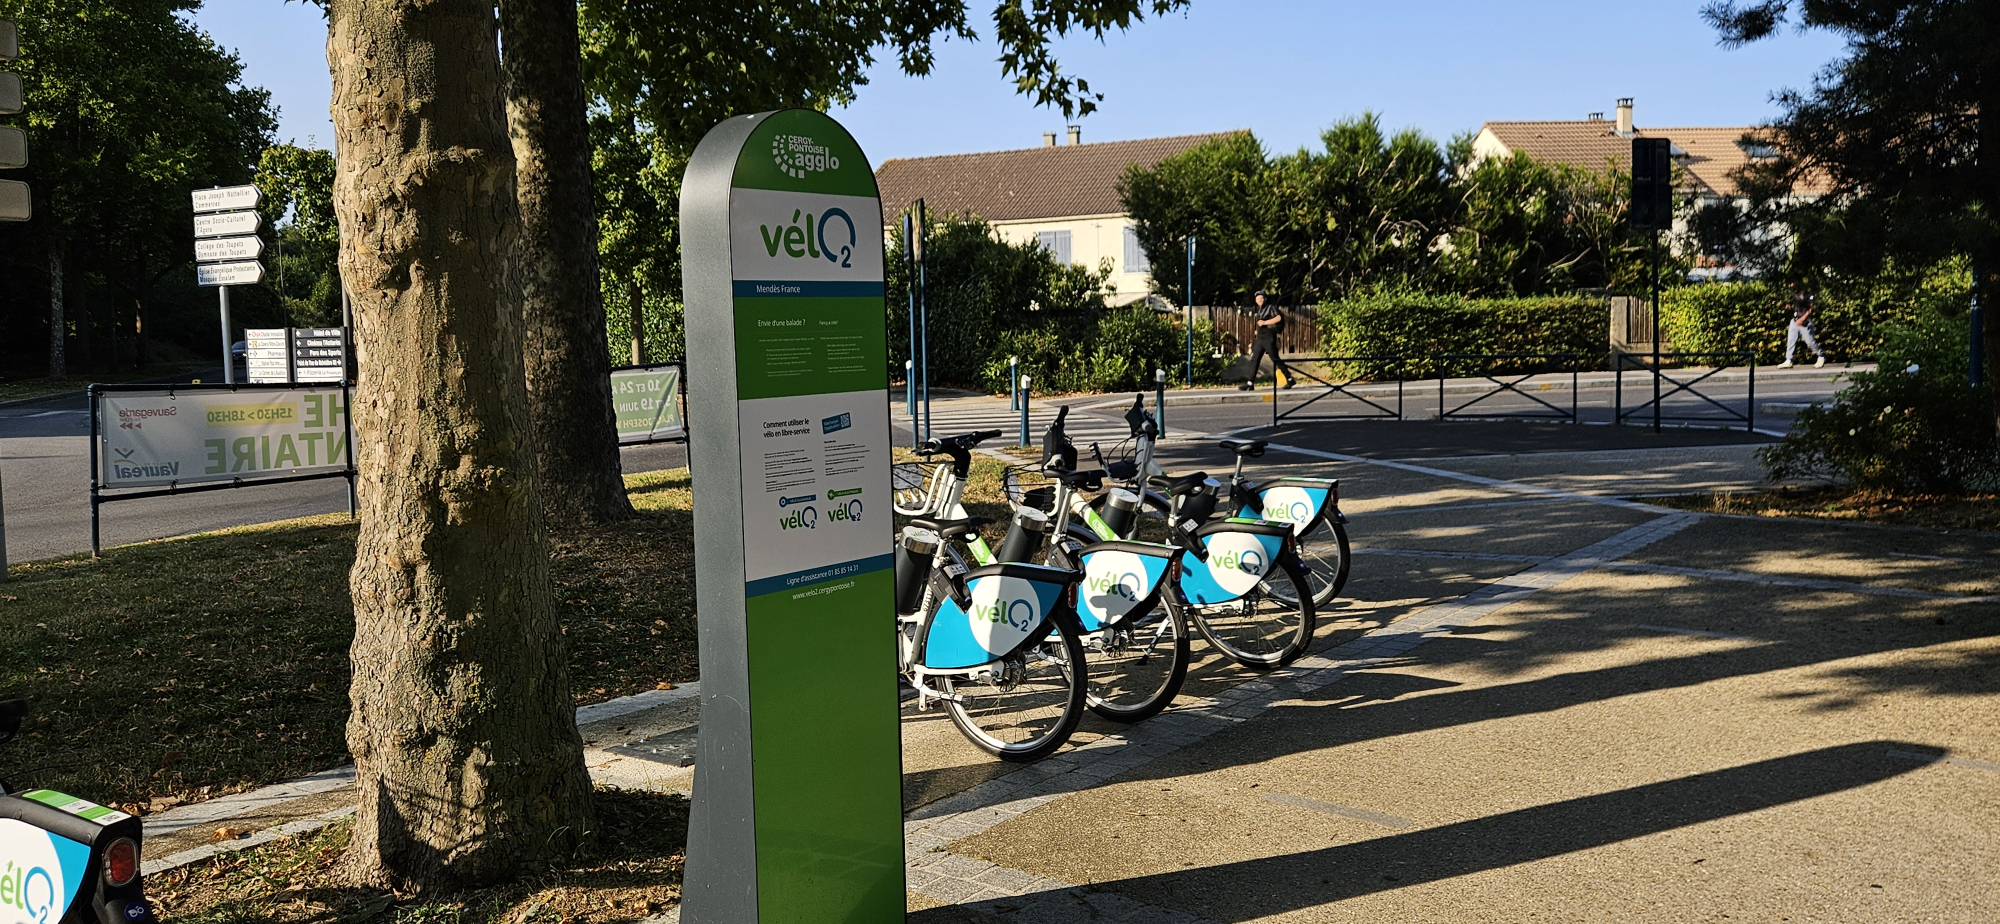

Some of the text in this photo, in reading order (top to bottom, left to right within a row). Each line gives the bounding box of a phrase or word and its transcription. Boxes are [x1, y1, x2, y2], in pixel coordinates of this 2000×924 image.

[795, 147, 839, 172] agglo
[208, 192, 224, 200] Joseph
[195, 201, 220, 209] Commerces
[196, 218, 211, 226] Centre
[227, 241, 244, 249] Toupets
[197, 251, 218, 259] Gymnase
[756, 284, 800, 293] Mendès France
[758, 319, 771, 327] Envie
[772, 319, 785, 327] d'une
[327, 349, 341, 357] Sports
[763, 420, 787, 429] Comment
[787, 418, 804, 426] utiliser
[763, 429, 774, 438] vélo
[781, 427, 810, 437] libre-service
[786, 577, 800, 586] Ligne
[800, 571, 827, 583] d'assistance
[792, 580, 855, 600] www.velo2.cergypontoise.fr
